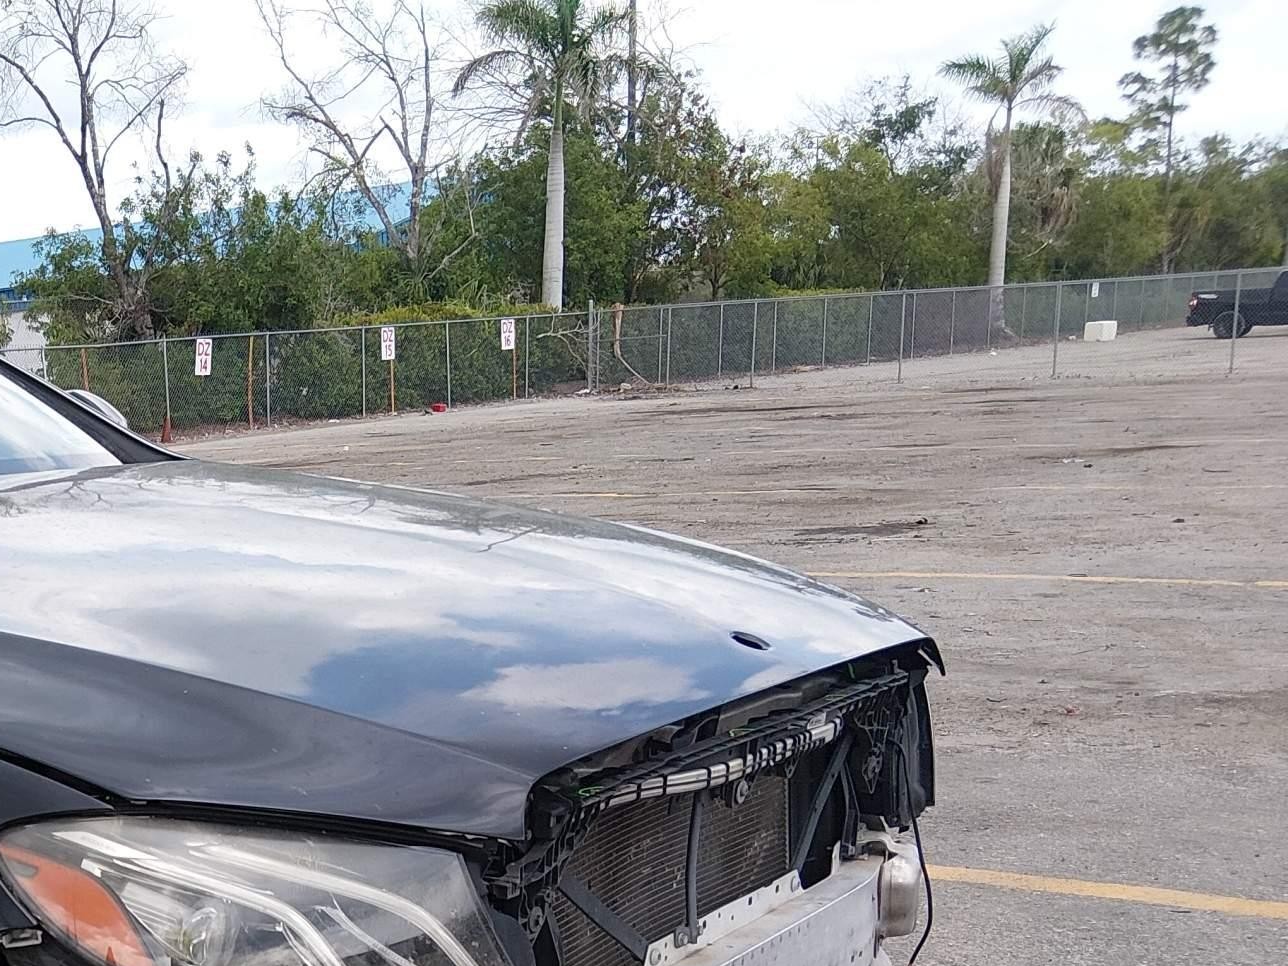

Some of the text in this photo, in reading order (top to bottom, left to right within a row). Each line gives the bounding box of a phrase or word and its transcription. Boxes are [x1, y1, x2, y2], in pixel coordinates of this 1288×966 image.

[502, 321, 513, 334] DZ
[382, 329, 394, 343] DZ
[504, 334, 512, 347] 16
[197, 342, 211, 356] DZ
[385, 344, 393, 358] 15
[199, 358, 208, 372] 14
